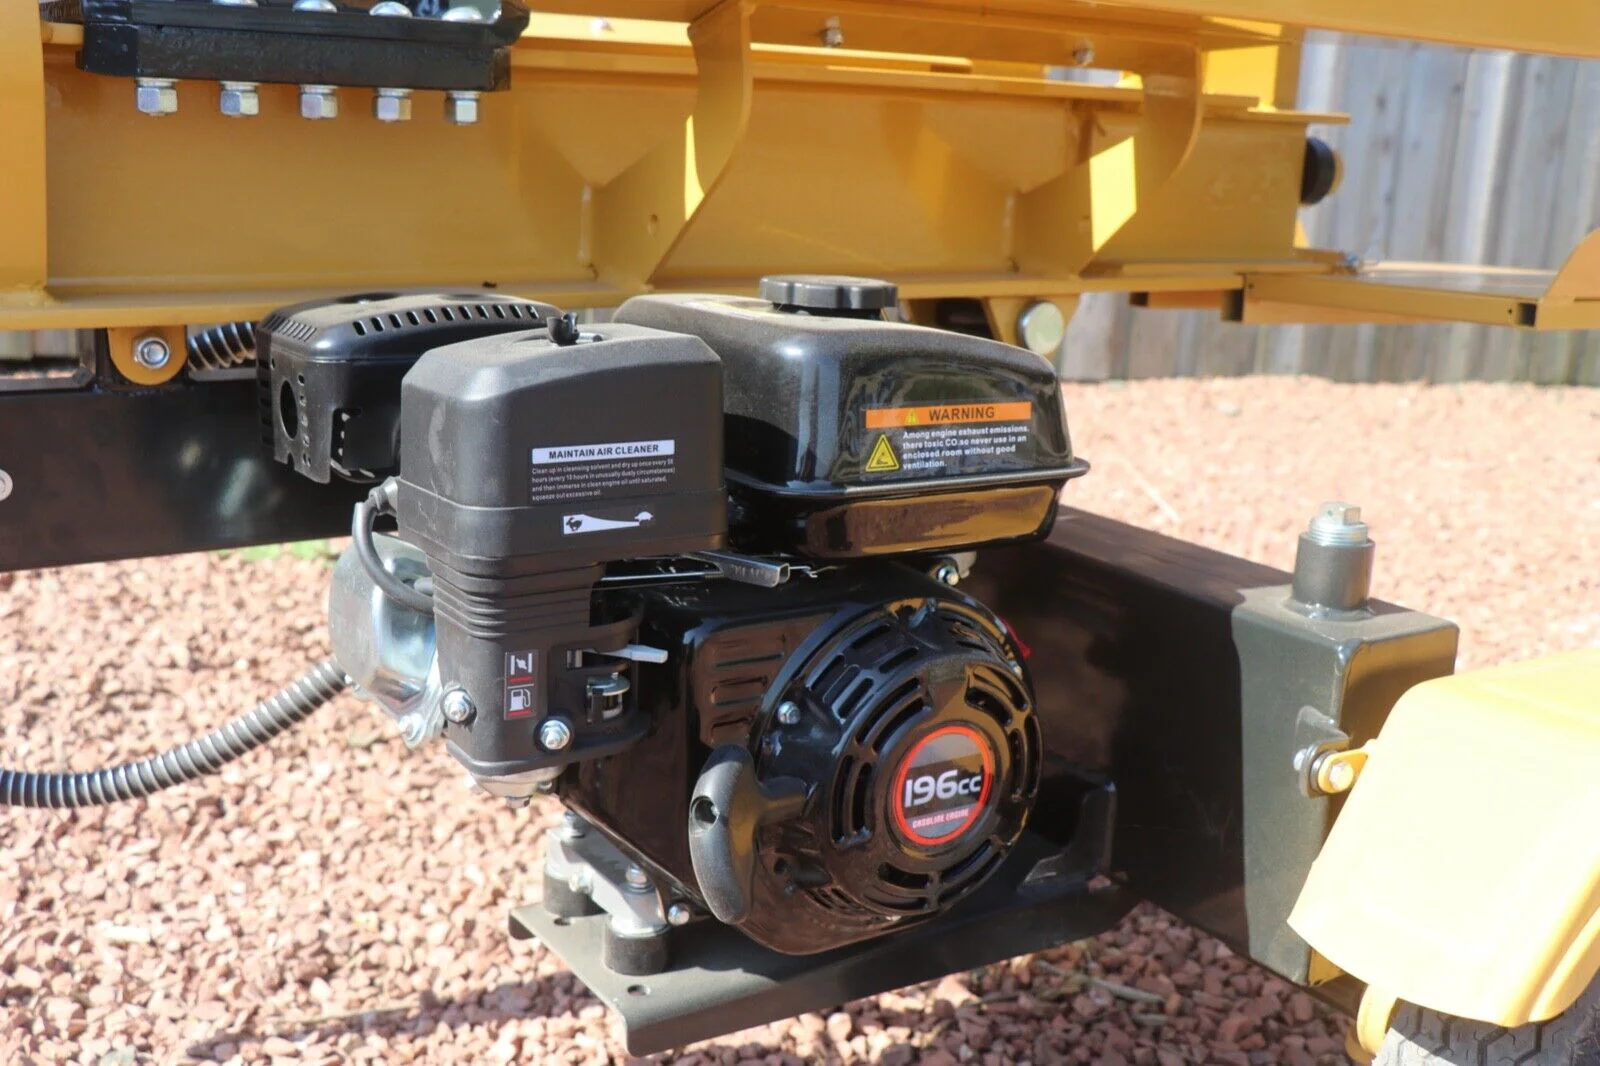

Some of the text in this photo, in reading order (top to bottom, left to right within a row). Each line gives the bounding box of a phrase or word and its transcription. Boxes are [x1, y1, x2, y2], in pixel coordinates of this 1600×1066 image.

[929, 406, 995, 422] WARNING
[903, 430, 930, 440] Among
[931, 428, 957, 439] engine
[903, 442, 922, 450] there
[1008, 434, 1016, 442] in
[549, 444, 659, 459] MAINTAIN AIR CLEANER
[903, 444, 1016, 460] enclosed room without good
[904, 769, 982, 808] 196cc
